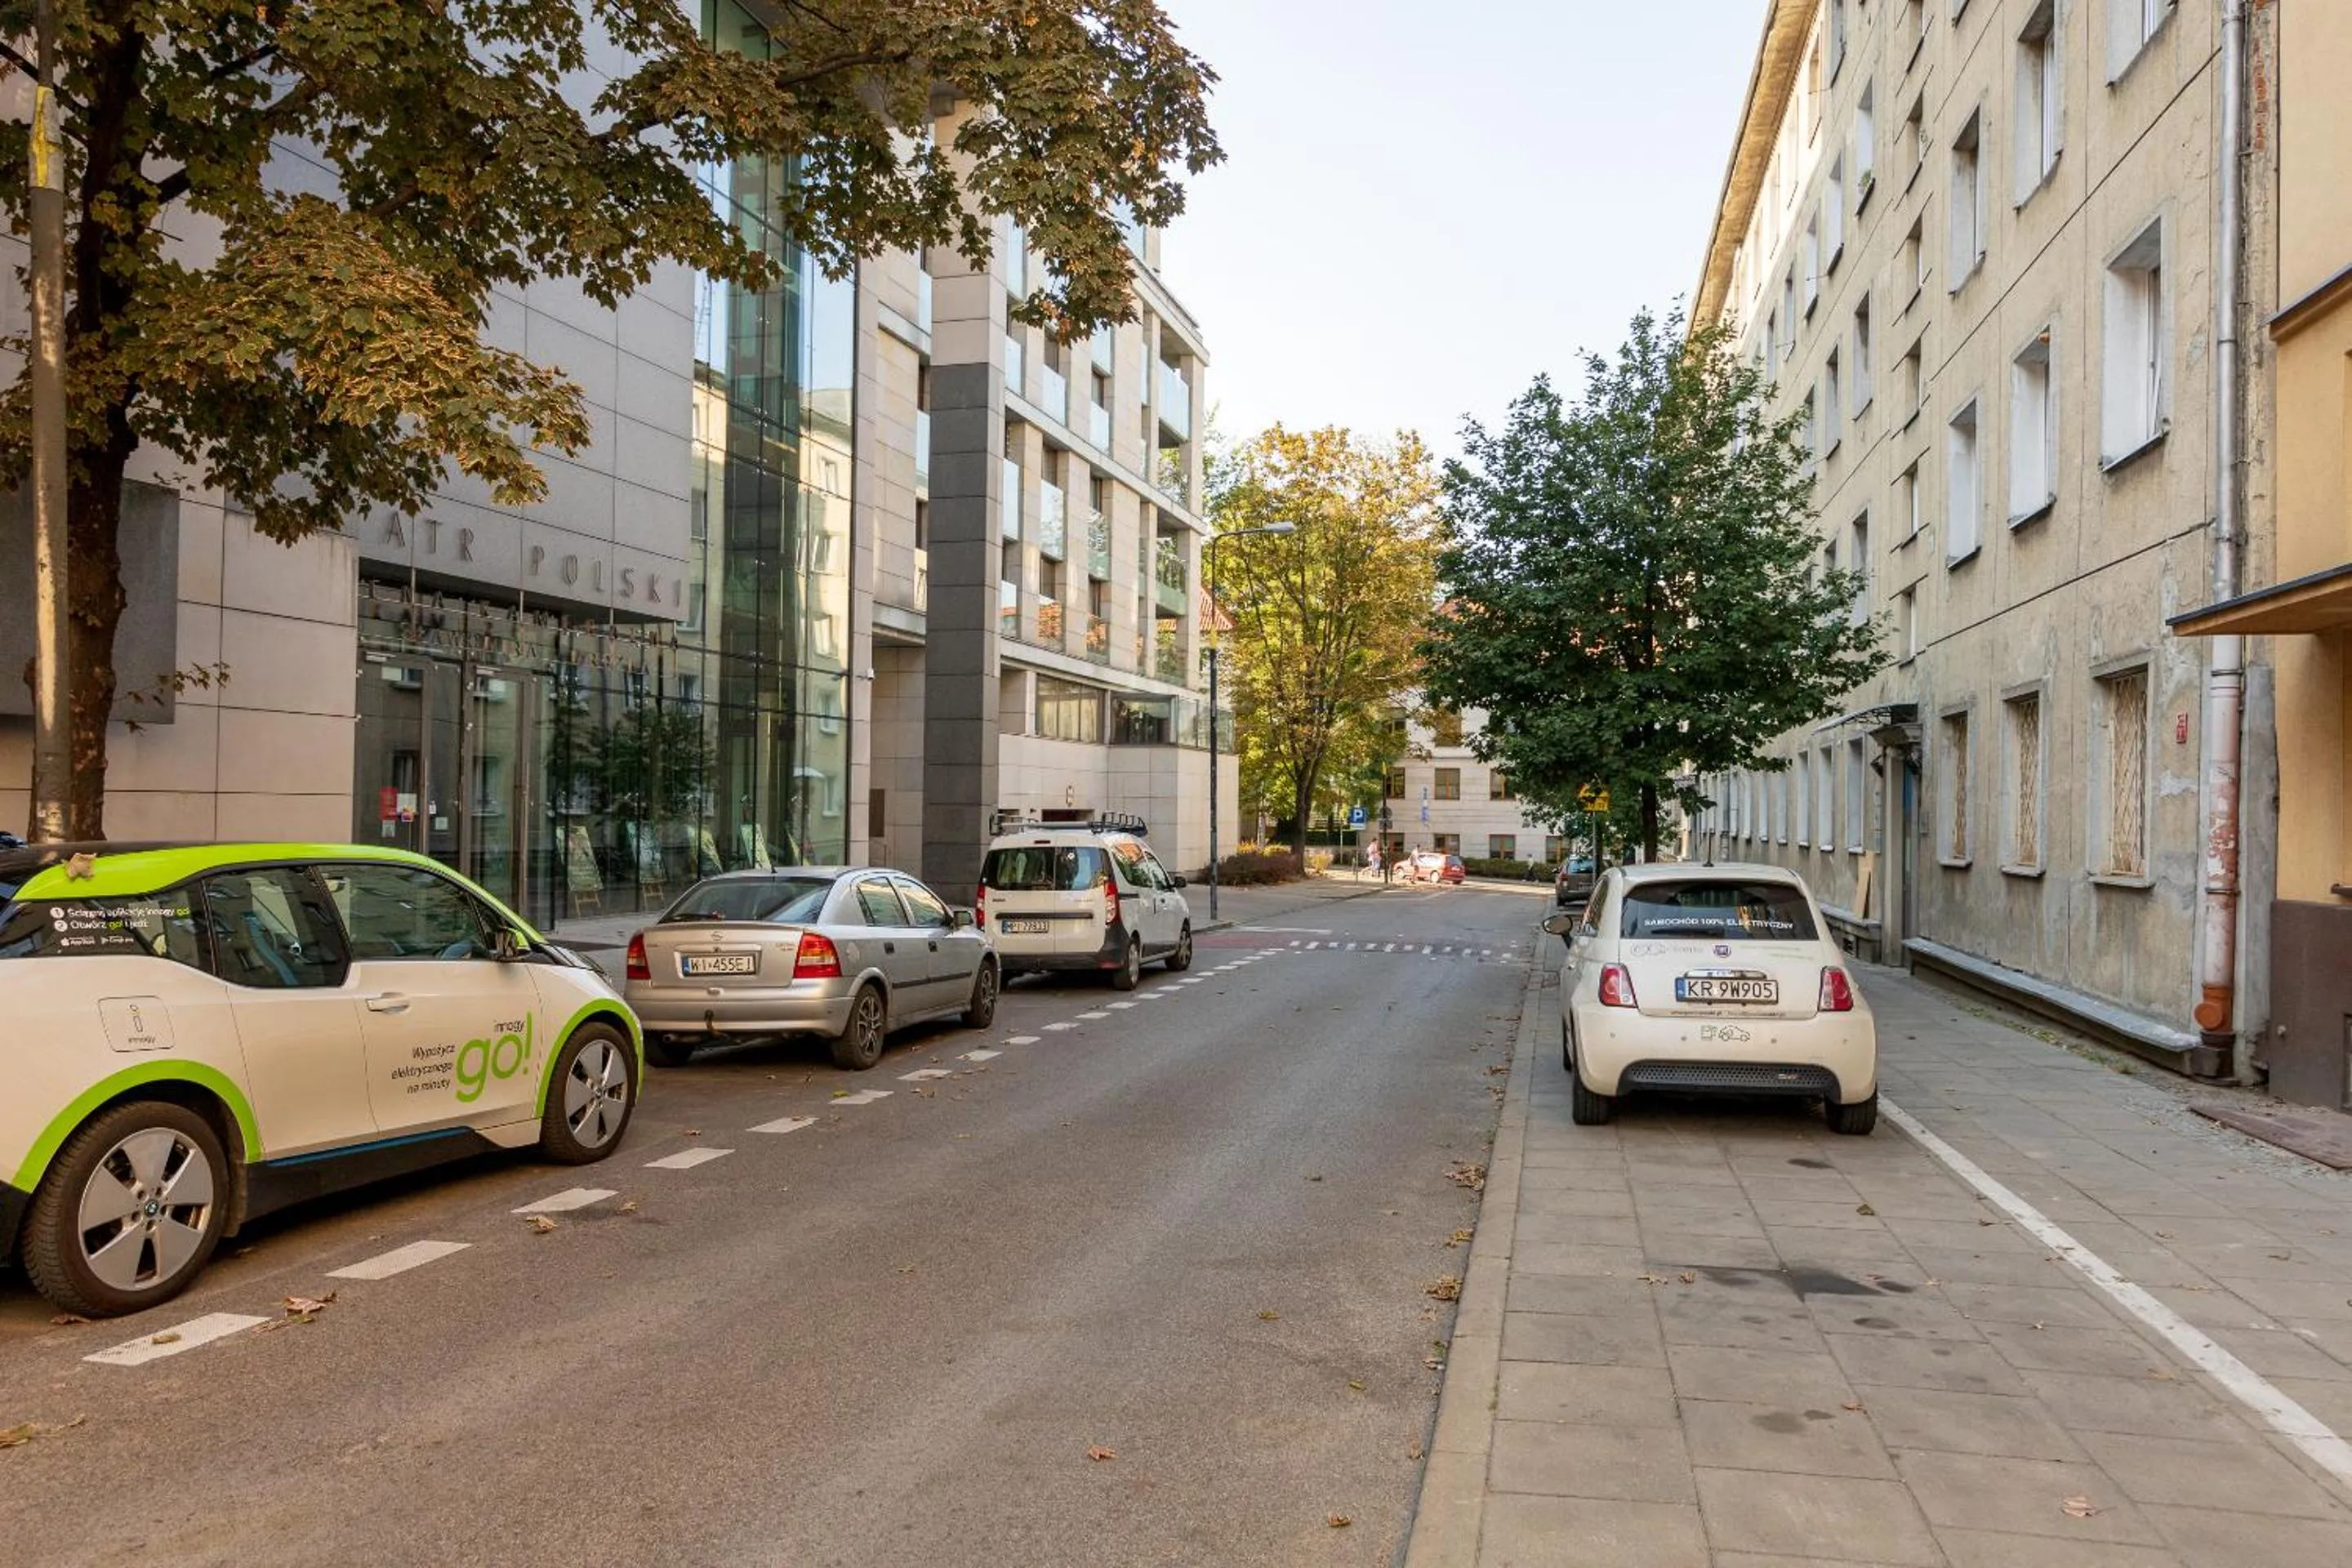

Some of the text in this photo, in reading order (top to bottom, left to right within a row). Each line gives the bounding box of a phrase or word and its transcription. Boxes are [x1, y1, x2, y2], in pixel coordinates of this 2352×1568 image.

[386, 510, 681, 608] ATR POLSKI
[1354, 809, 1363, 822] P
[1687, 981, 1773, 998] KR 9W905
[493, 1019, 525, 1033] innogy
[455, 1011, 532, 1103] go!
